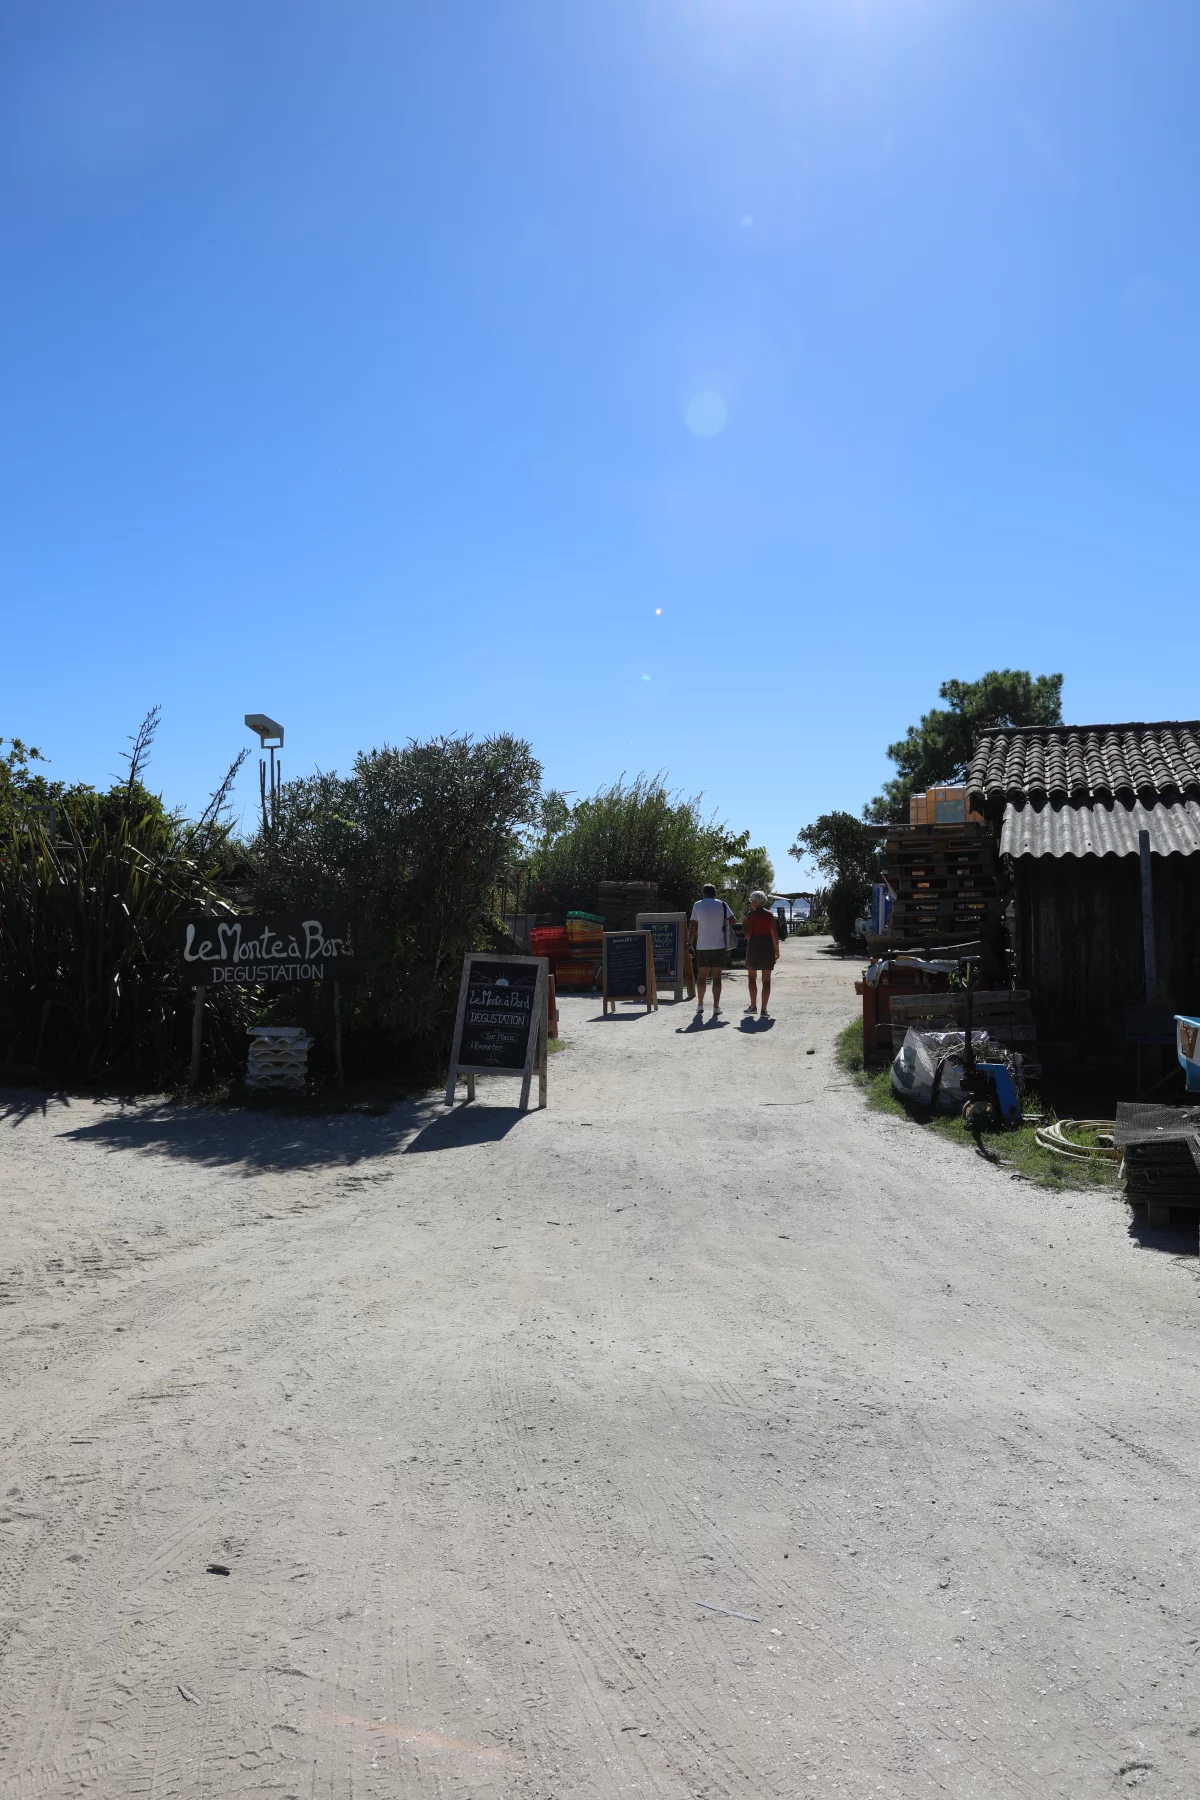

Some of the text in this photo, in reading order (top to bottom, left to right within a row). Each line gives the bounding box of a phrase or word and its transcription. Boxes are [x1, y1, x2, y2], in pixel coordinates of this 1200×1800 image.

[183, 923, 220, 962] Le
[218, 922, 288, 963] Monte
[288, 934, 302, 959] à
[211, 964, 324, 983] DEGUSTATION
[469, 990, 481, 1004] Le
[482, 990, 503, 1006] Monte
[510, 991, 530, 1009] Bord
[470, 1012, 525, 1025] DEGUSTATION
[485, 1032, 515, 1041] Sur Place
